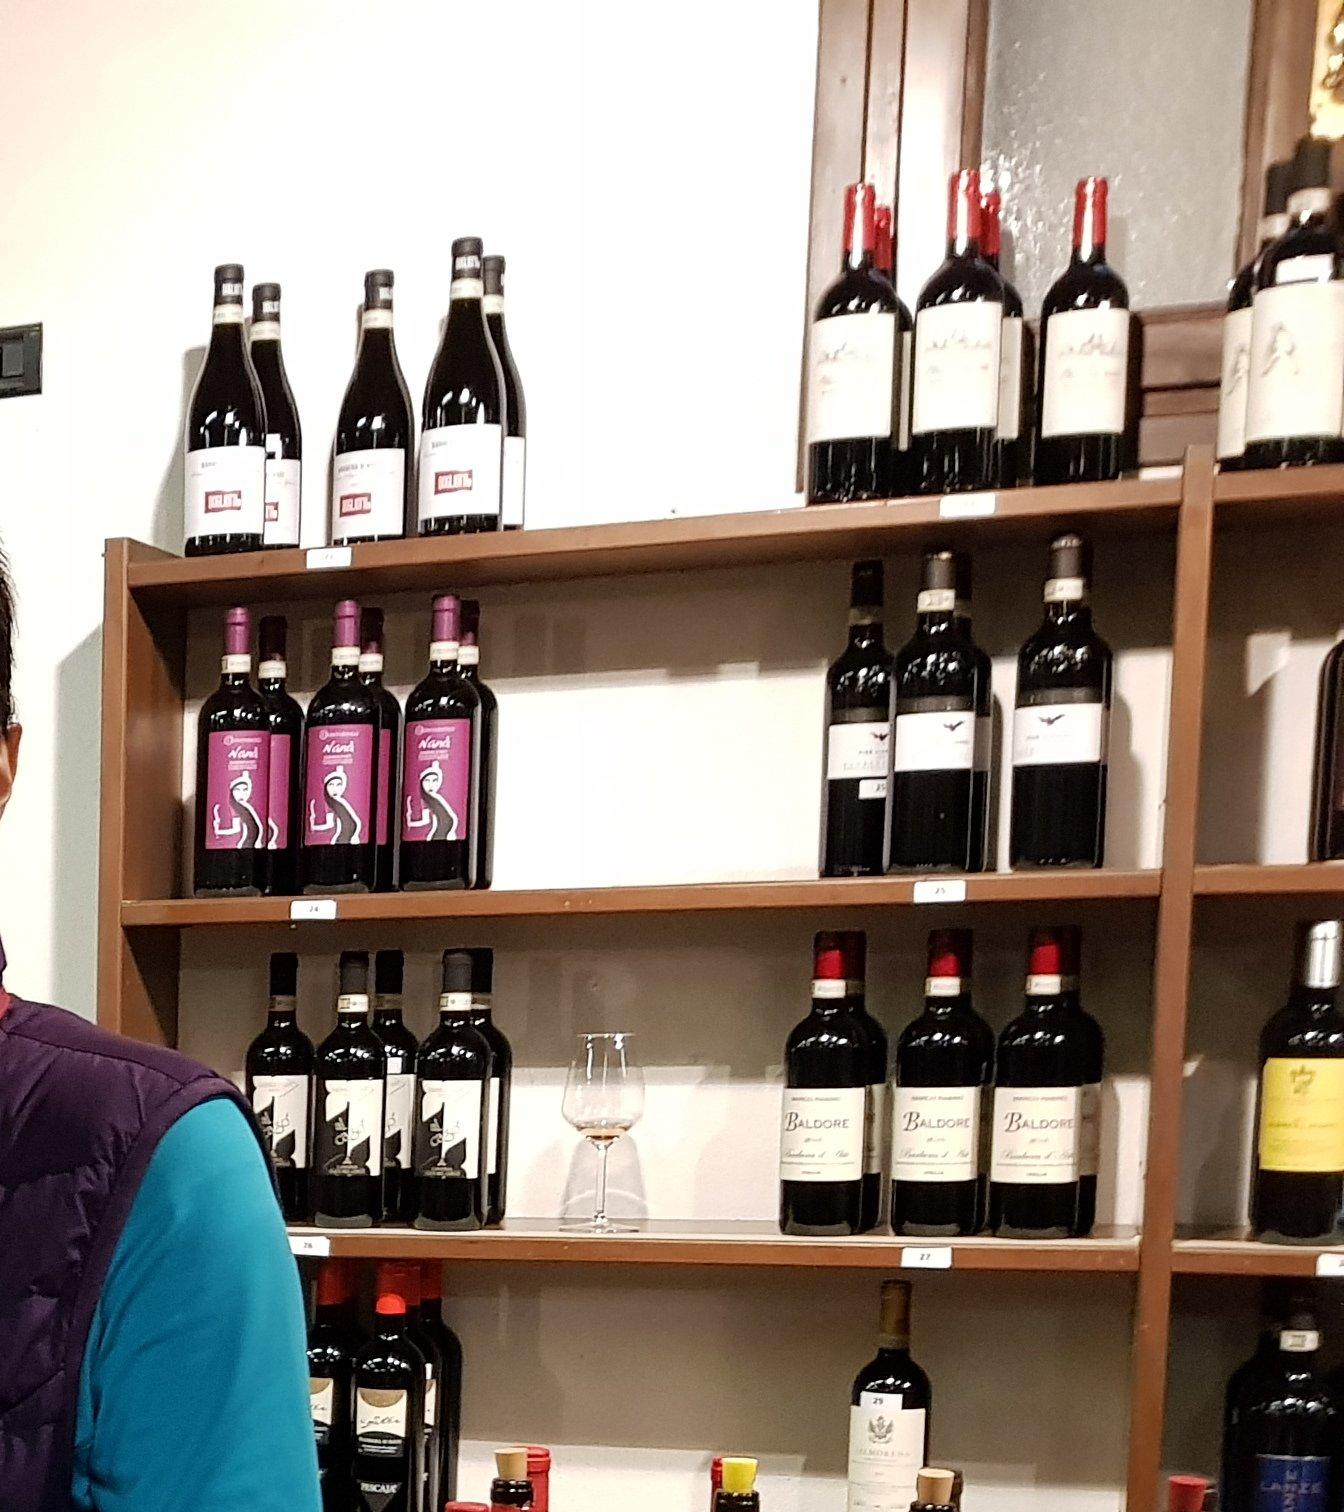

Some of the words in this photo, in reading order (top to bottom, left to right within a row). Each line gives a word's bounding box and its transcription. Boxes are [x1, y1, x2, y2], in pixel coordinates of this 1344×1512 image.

[784, 1111, 849, 1132] BALDORE
[902, 1111, 970, 1132] BALDORE
[1004, 1111, 1075, 1133] BALDORE
